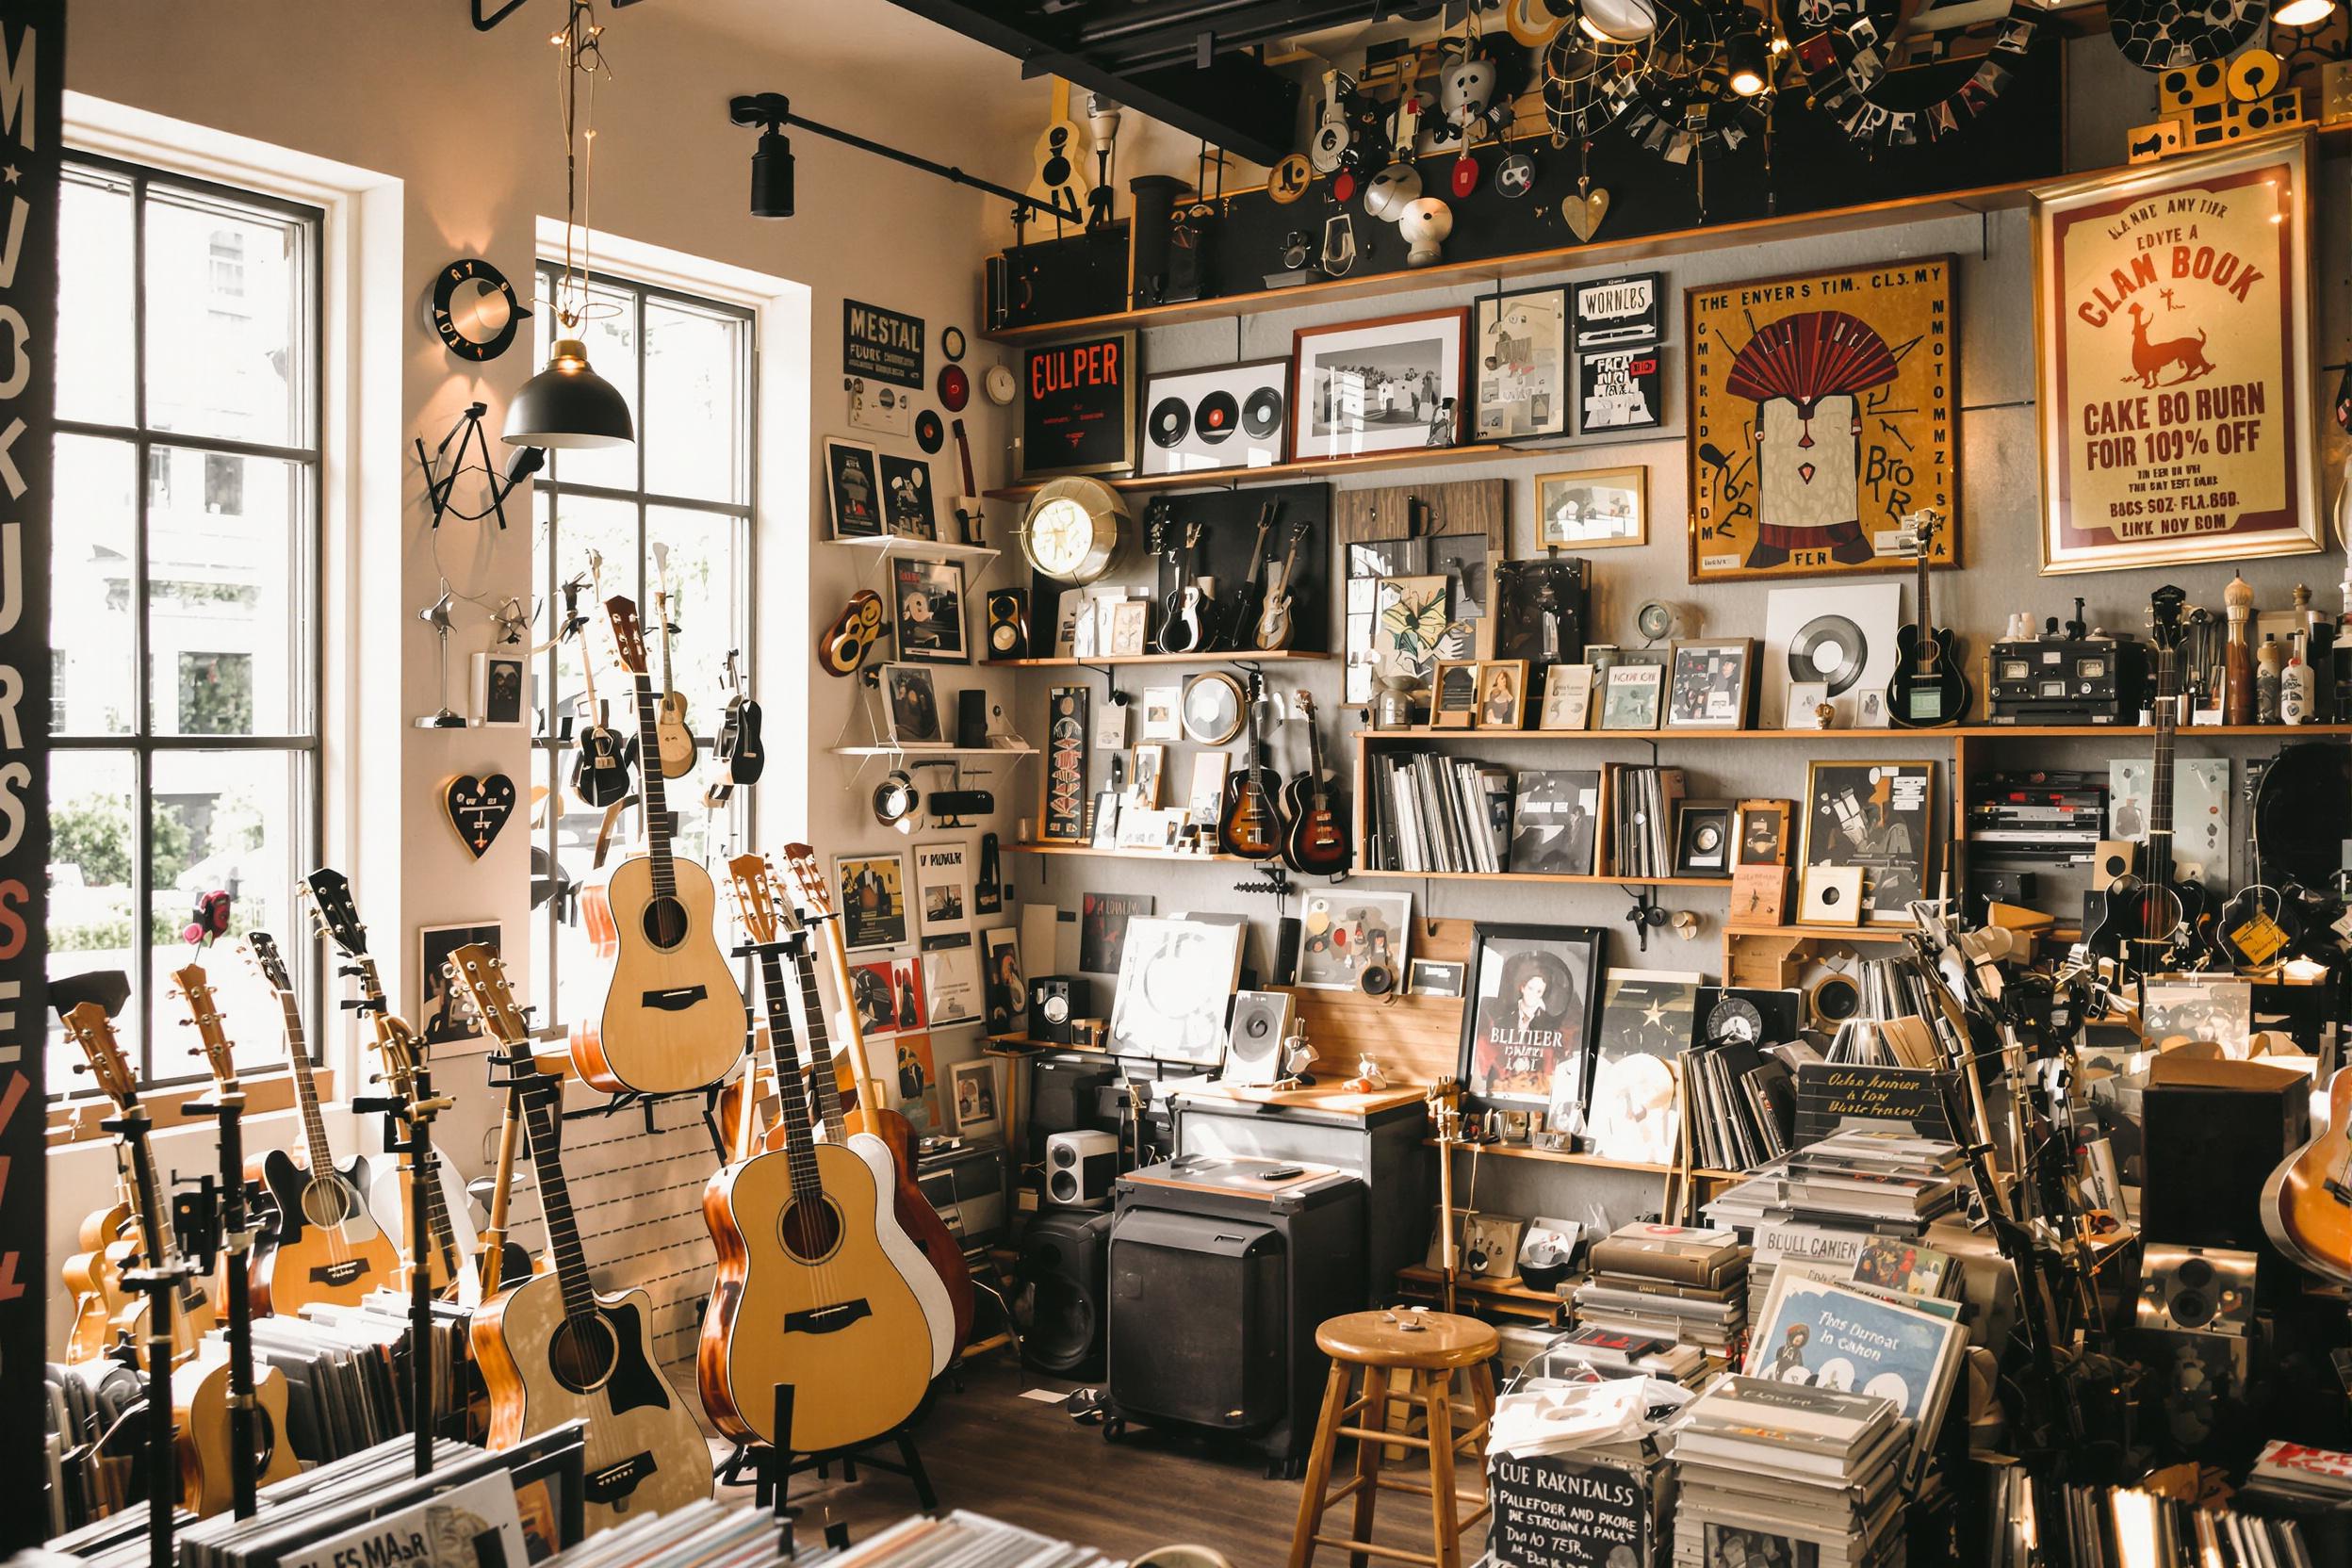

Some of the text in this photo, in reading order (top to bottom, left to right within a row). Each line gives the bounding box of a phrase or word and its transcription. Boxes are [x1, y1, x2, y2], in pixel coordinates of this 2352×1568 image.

[2168, 198, 2196, 213] ANY
[2172, 246, 2264, 302] BOOK
[1700, 295, 1728, 312] THE
[851, 308, 920, 352] MESTAL
[2083, 397, 2150, 435] CAKE
[2158, 391, 2189, 426] BO
[2216, 420, 2261, 454] OFF
[1500, 1462, 1530, 1485] CUE
[1570, 1508, 1594, 1523] AND
